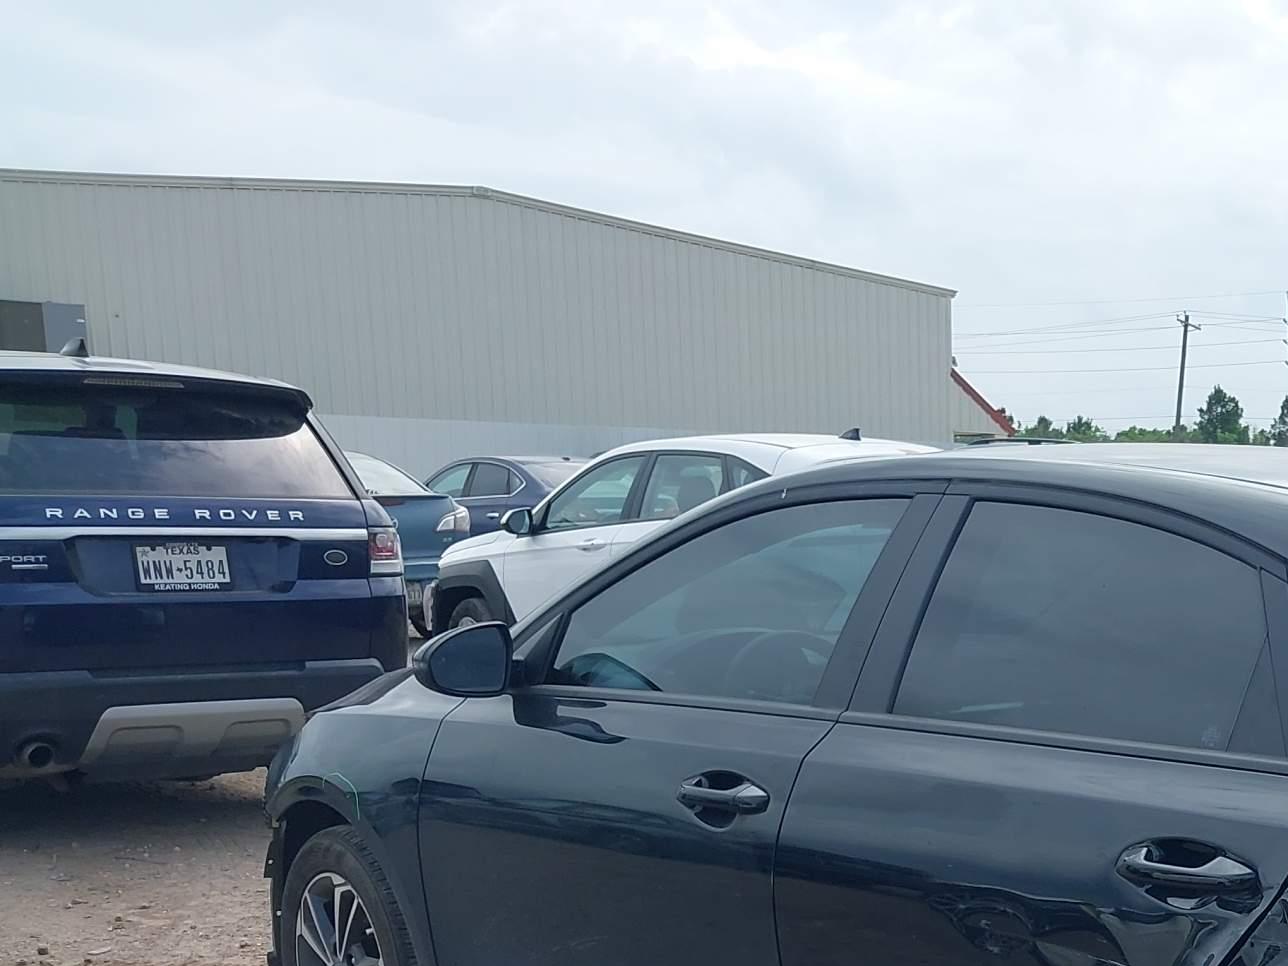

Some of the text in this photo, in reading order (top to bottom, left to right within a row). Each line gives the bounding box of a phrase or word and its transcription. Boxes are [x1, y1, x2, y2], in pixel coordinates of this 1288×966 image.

[45, 508, 305, 521] RANGE ROVER
[165, 545, 200, 556] TEXAS
[154, 583, 190, 591] KEATING
